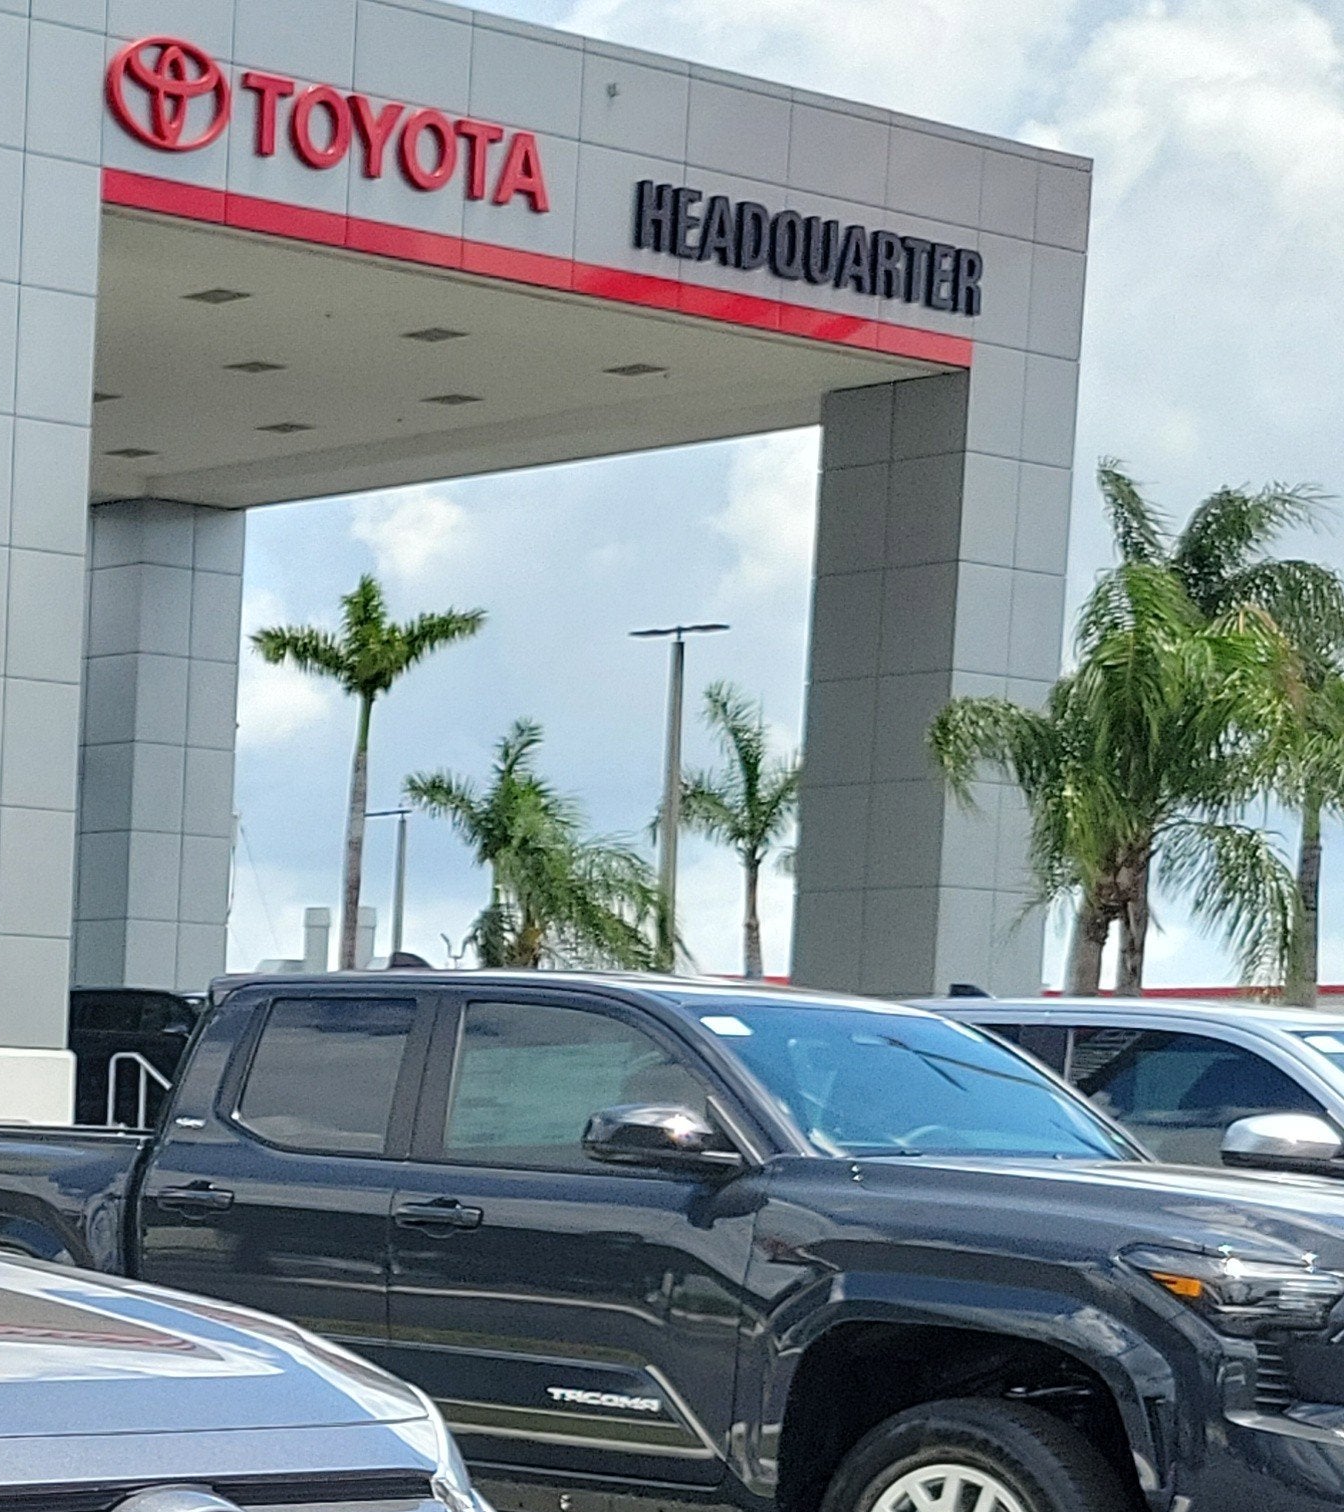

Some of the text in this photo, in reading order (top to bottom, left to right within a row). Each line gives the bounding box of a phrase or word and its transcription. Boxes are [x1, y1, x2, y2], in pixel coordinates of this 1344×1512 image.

[242, 70, 550, 213] TOYOTA
[633, 179, 984, 317] HEADQUARTER
[546, 1386, 661, 1413] TACOMA
